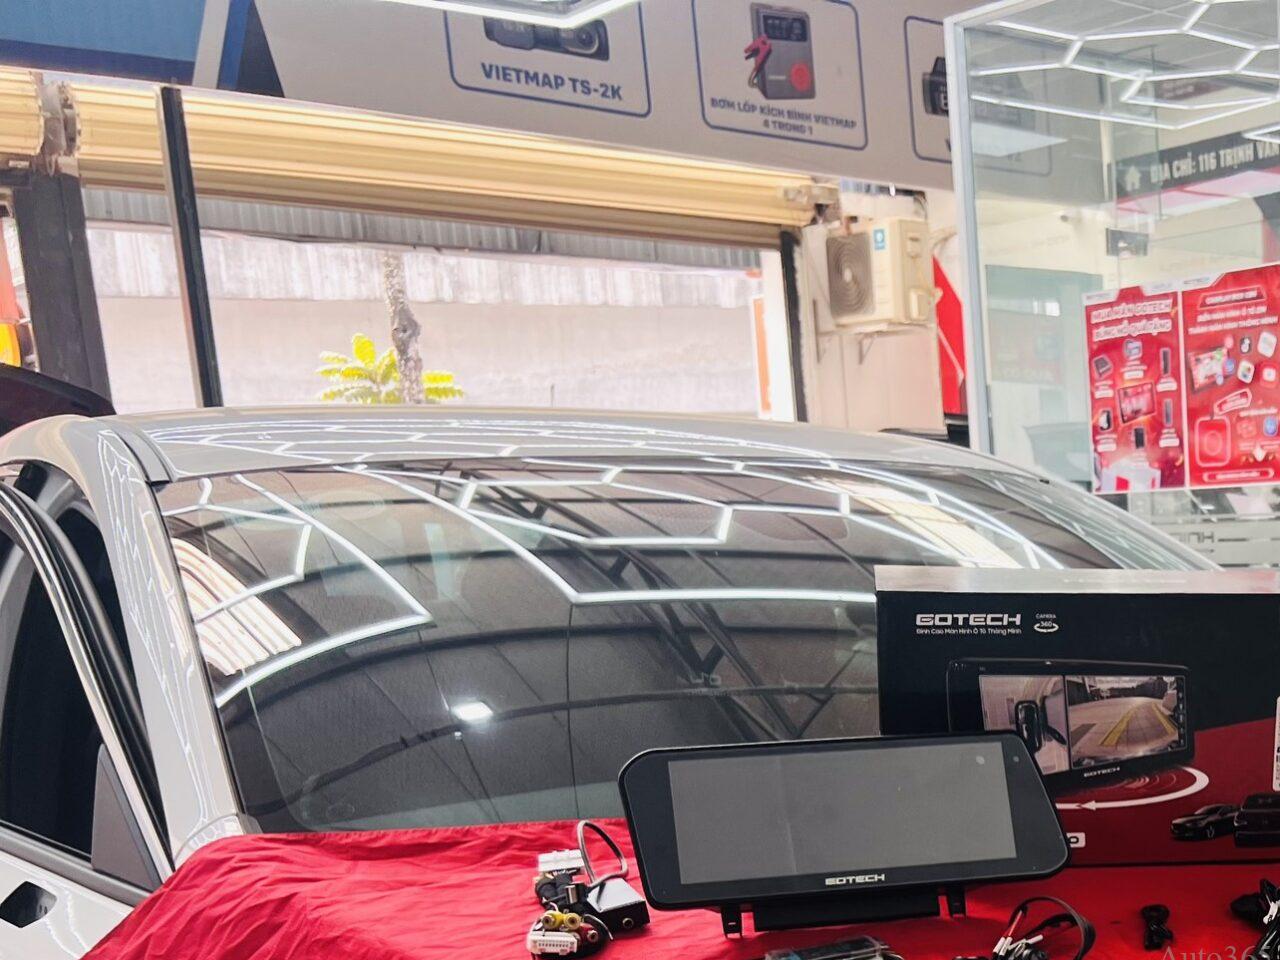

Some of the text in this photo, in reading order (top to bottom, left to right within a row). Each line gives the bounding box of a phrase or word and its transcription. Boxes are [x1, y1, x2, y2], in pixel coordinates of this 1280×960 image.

[481, 62, 623, 100] VIETMAP TS-2K
[772, 121, 807, 134] TRONG
[814, 114, 857, 129] VIETMAP
[1198, 154, 1217, 173] 116
[915, 613, 1022, 626] GOTECH
[825, 873, 886, 886] GOTECH
